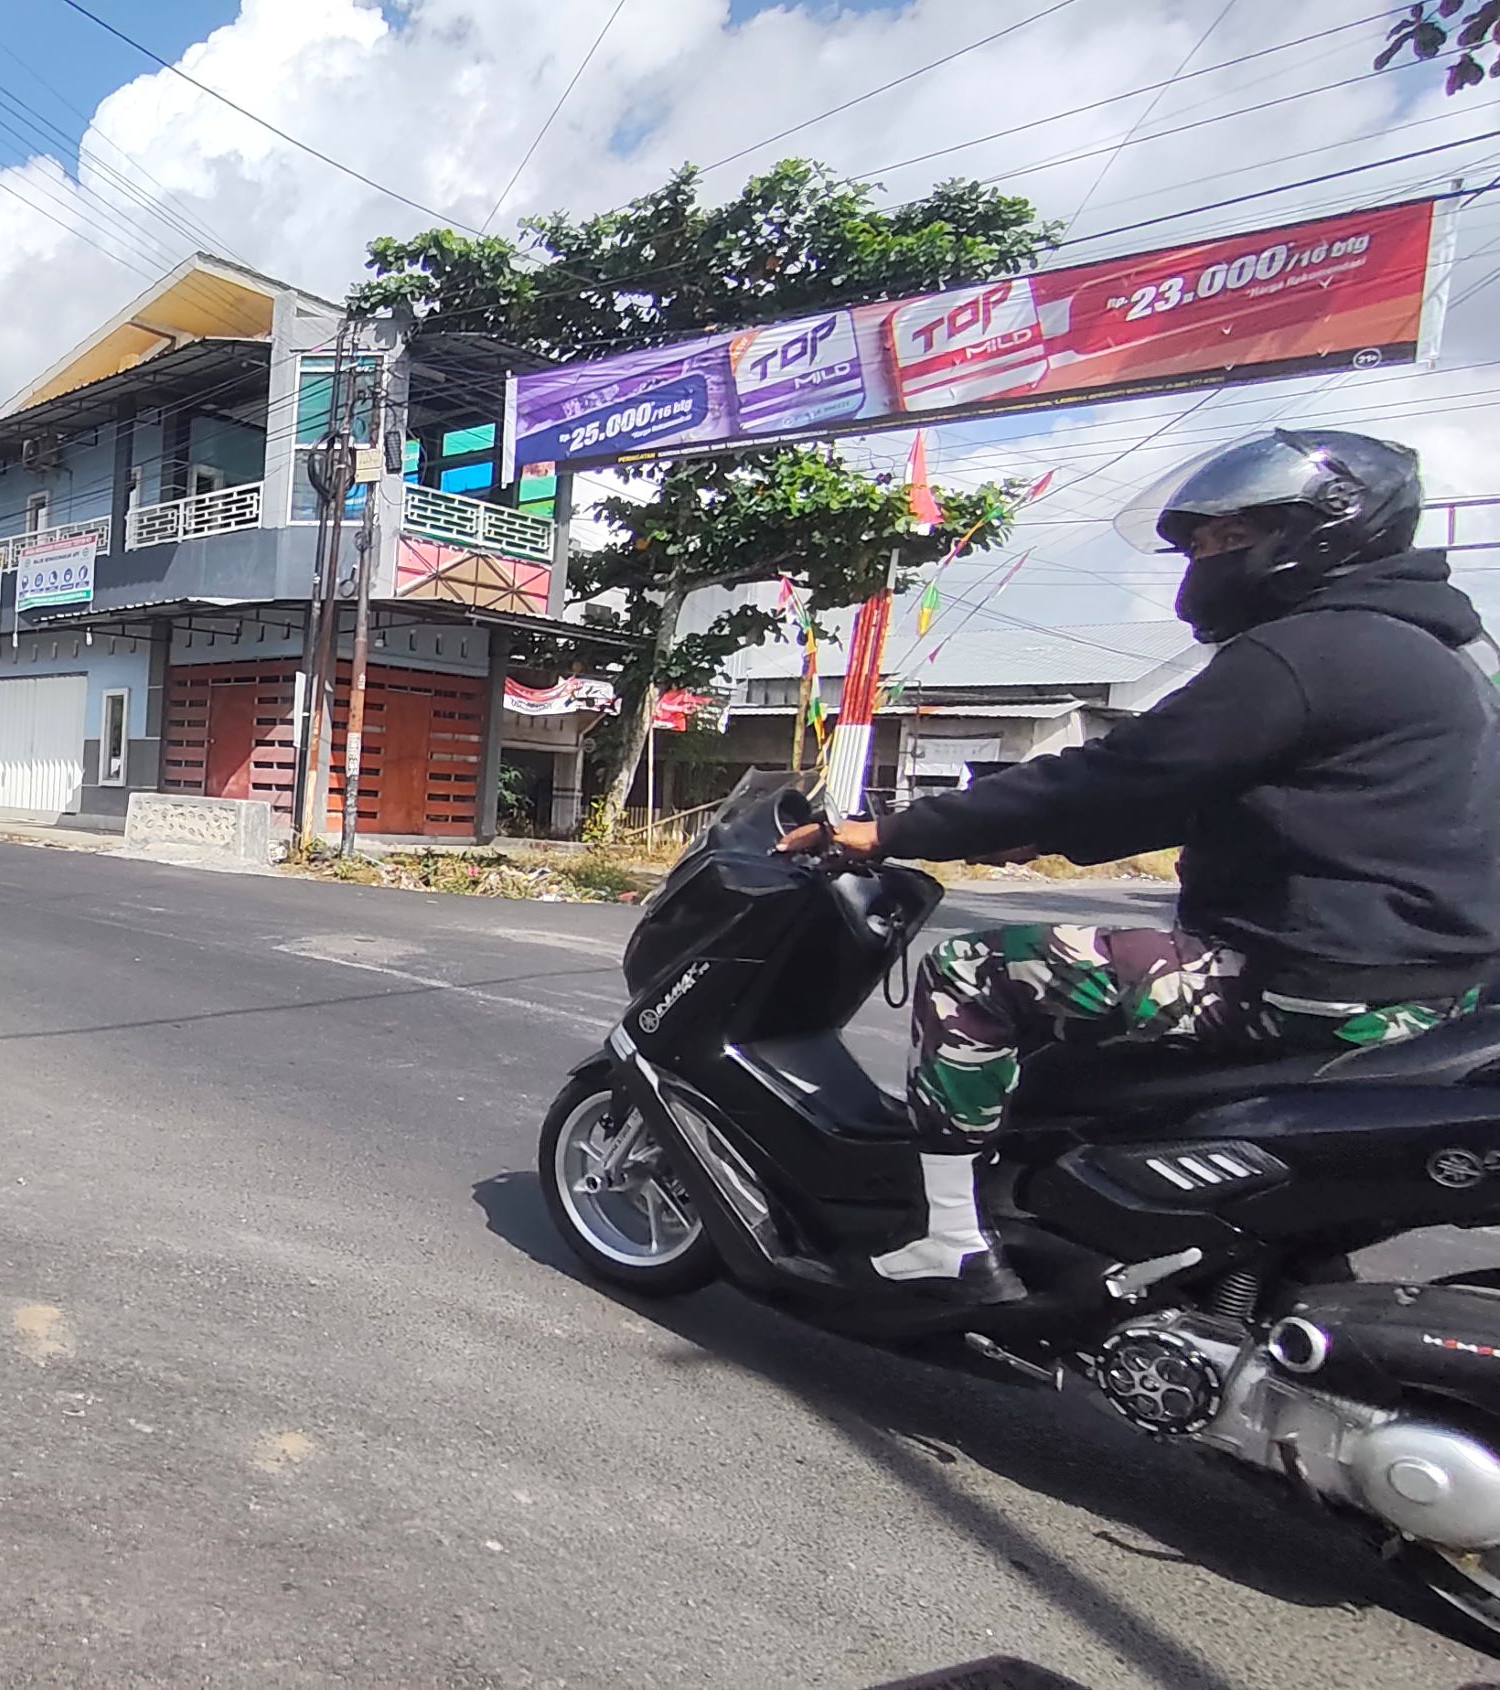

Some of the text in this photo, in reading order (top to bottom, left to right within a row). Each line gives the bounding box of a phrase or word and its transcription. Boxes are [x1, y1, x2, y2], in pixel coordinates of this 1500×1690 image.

[1330, 234, 1370, 257] btg
[911, 281, 1013, 353] TOP
[750, 315, 837, 381] TOP
[965, 328, 1032, 360] MILD
[794, 362, 851, 389] MILD
[656, 962, 698, 1018] NMAX
